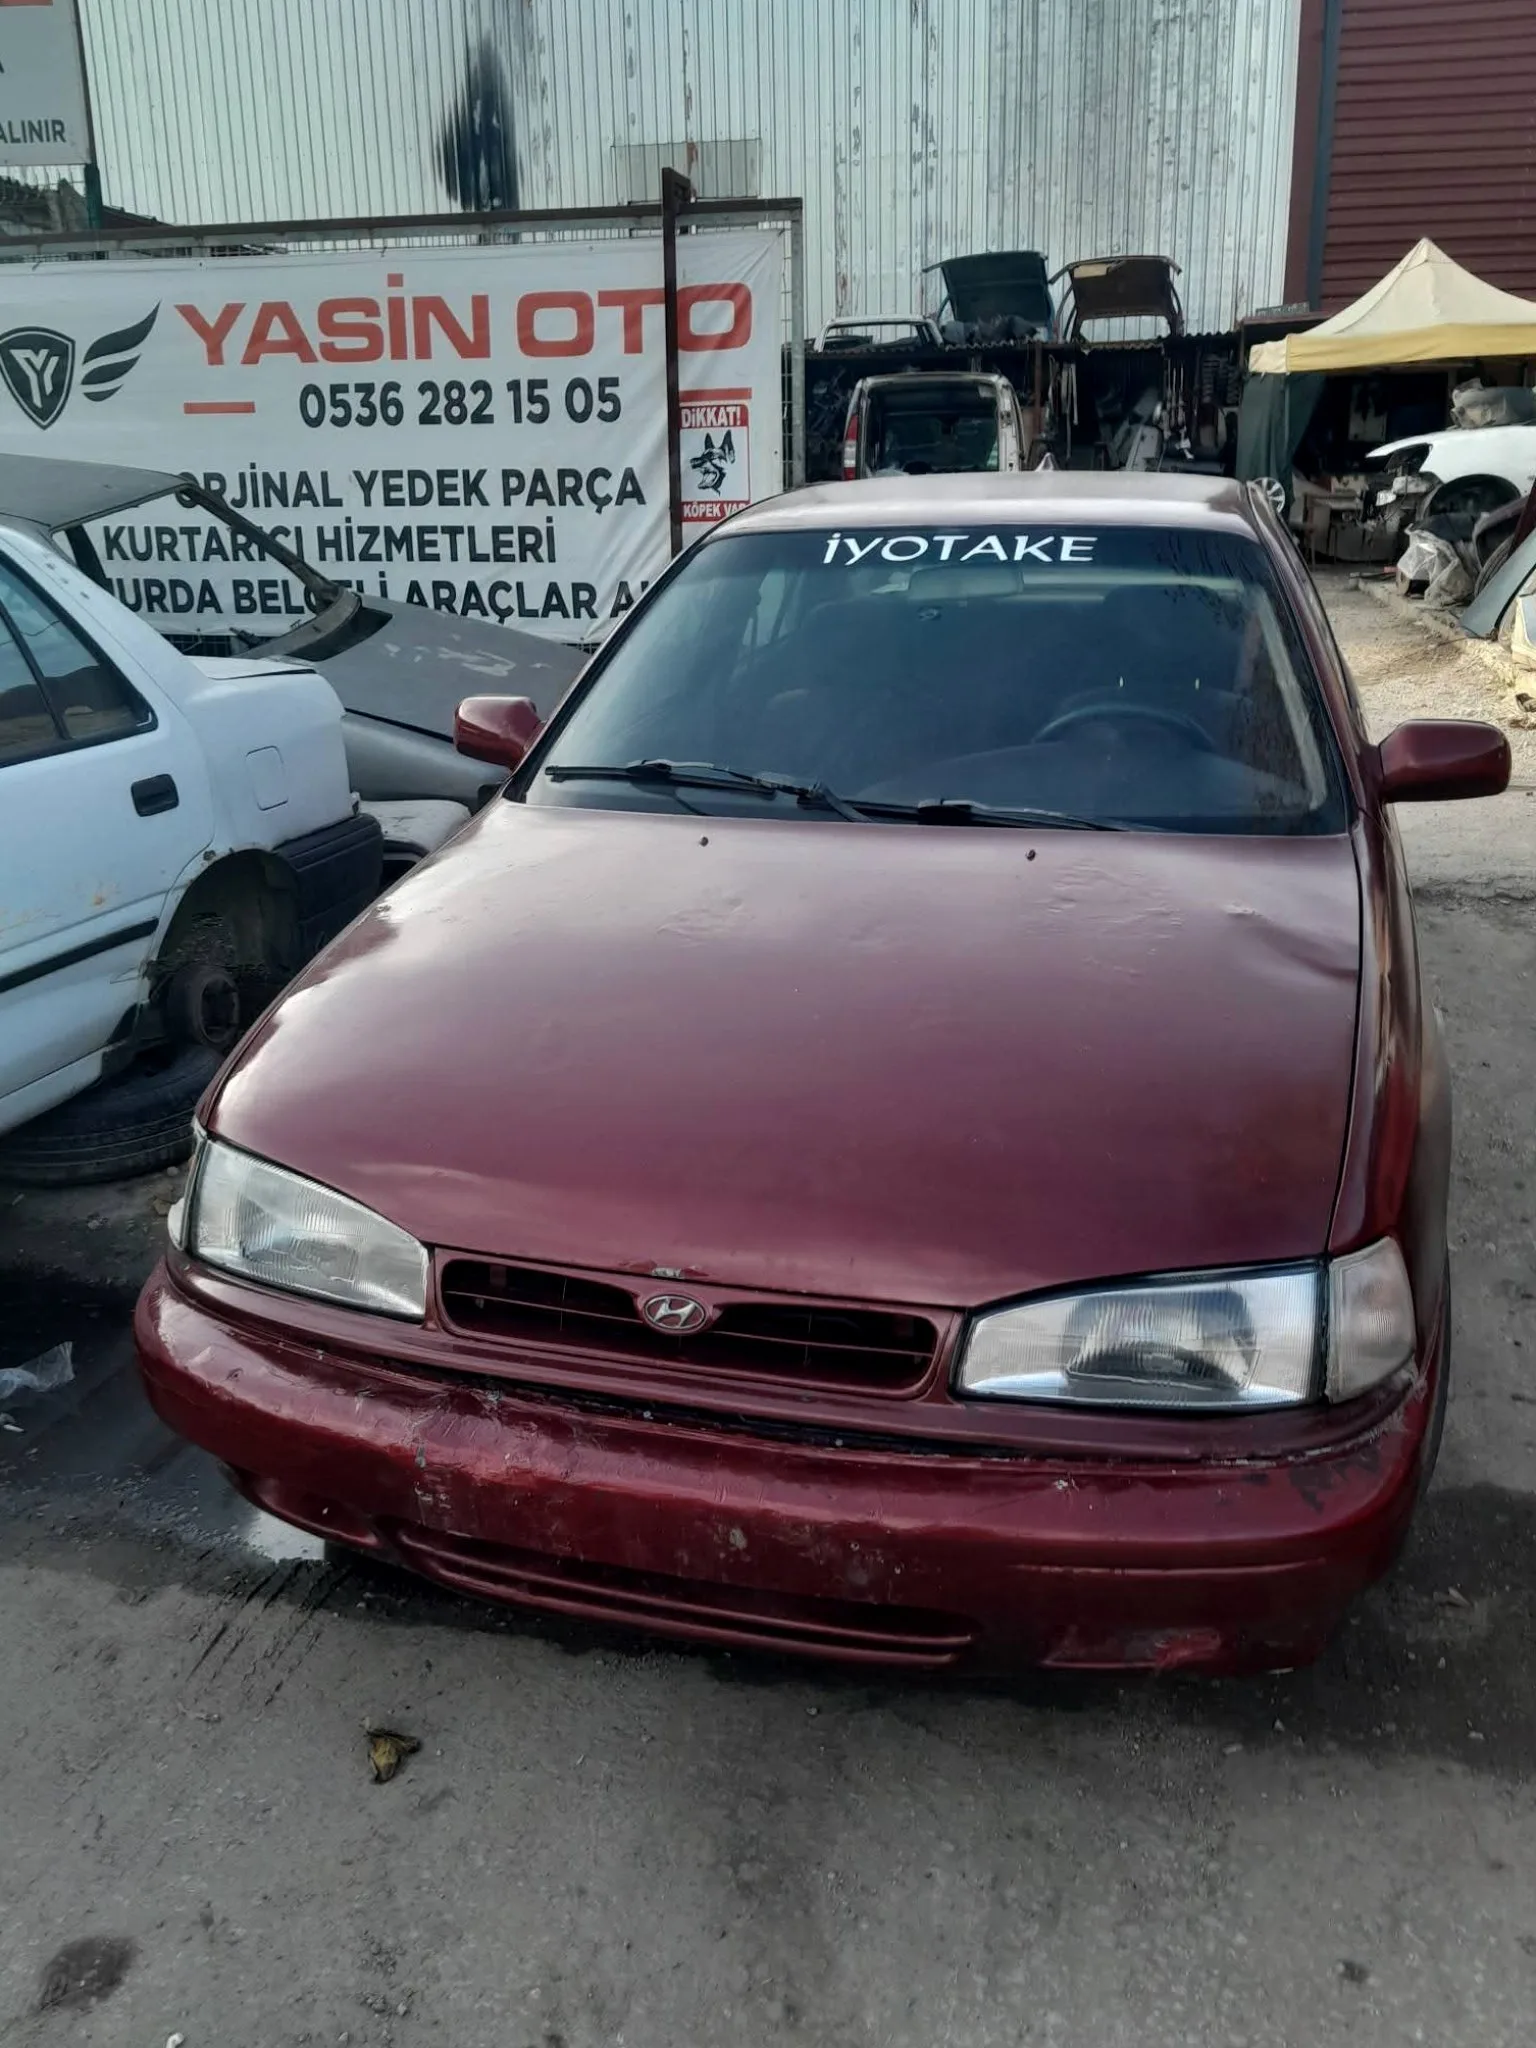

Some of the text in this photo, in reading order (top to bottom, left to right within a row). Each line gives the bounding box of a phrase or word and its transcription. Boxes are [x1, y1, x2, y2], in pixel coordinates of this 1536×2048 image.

[173, 272, 753, 366] YASİN OTO
[300, 376, 622, 428] 0536 282 15 05
[352, 468, 490, 507] YEDEK
[501, 467, 647, 514] PARÇA
[683, 502, 721, 517] KÖPEK
[316, 516, 556, 563] HİZMETLERİ
[106, 577, 223, 614] URDA
[406, 580, 599, 625] ARAÇLAR
